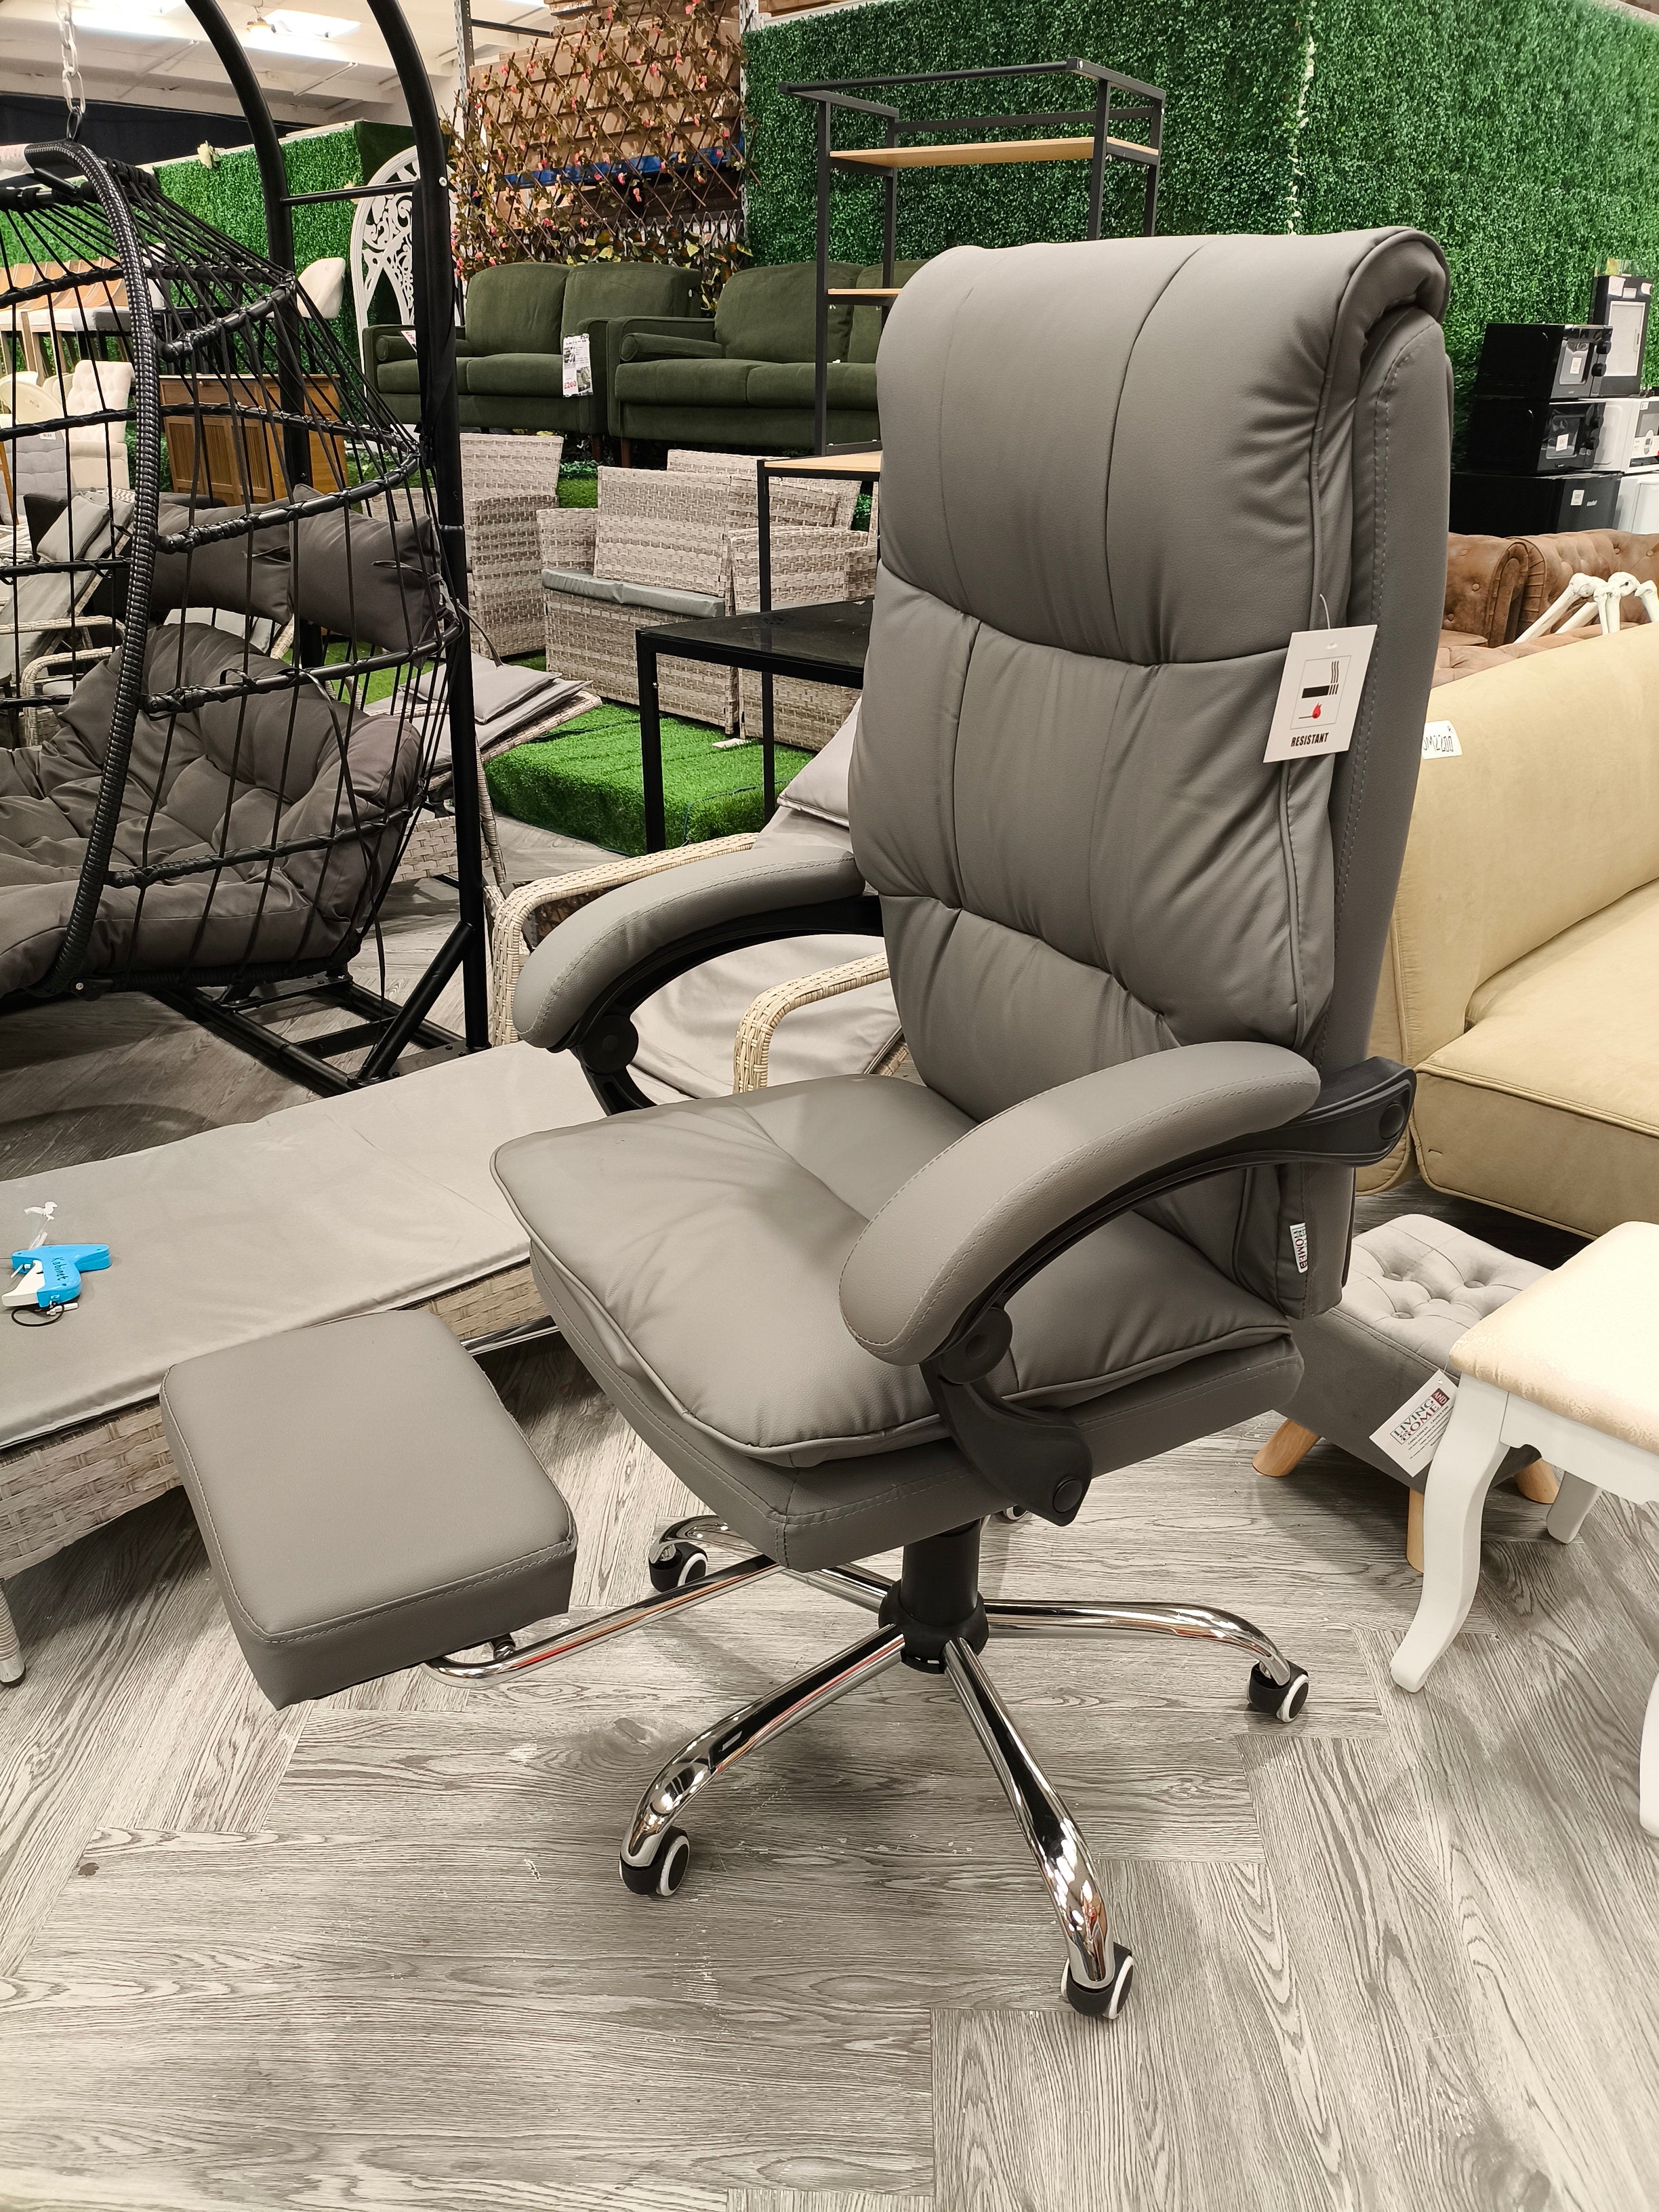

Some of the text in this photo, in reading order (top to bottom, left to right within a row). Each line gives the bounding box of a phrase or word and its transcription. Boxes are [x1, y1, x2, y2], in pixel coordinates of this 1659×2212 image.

[564, 380, 577, 389] £200
[1290, 732, 1329, 747] RESISTANT
[1433, 1391, 1448, 1405] AND
[1393, 1399, 1433, 1436] LIVING
[1399, 1403, 1439, 1441] HOME
